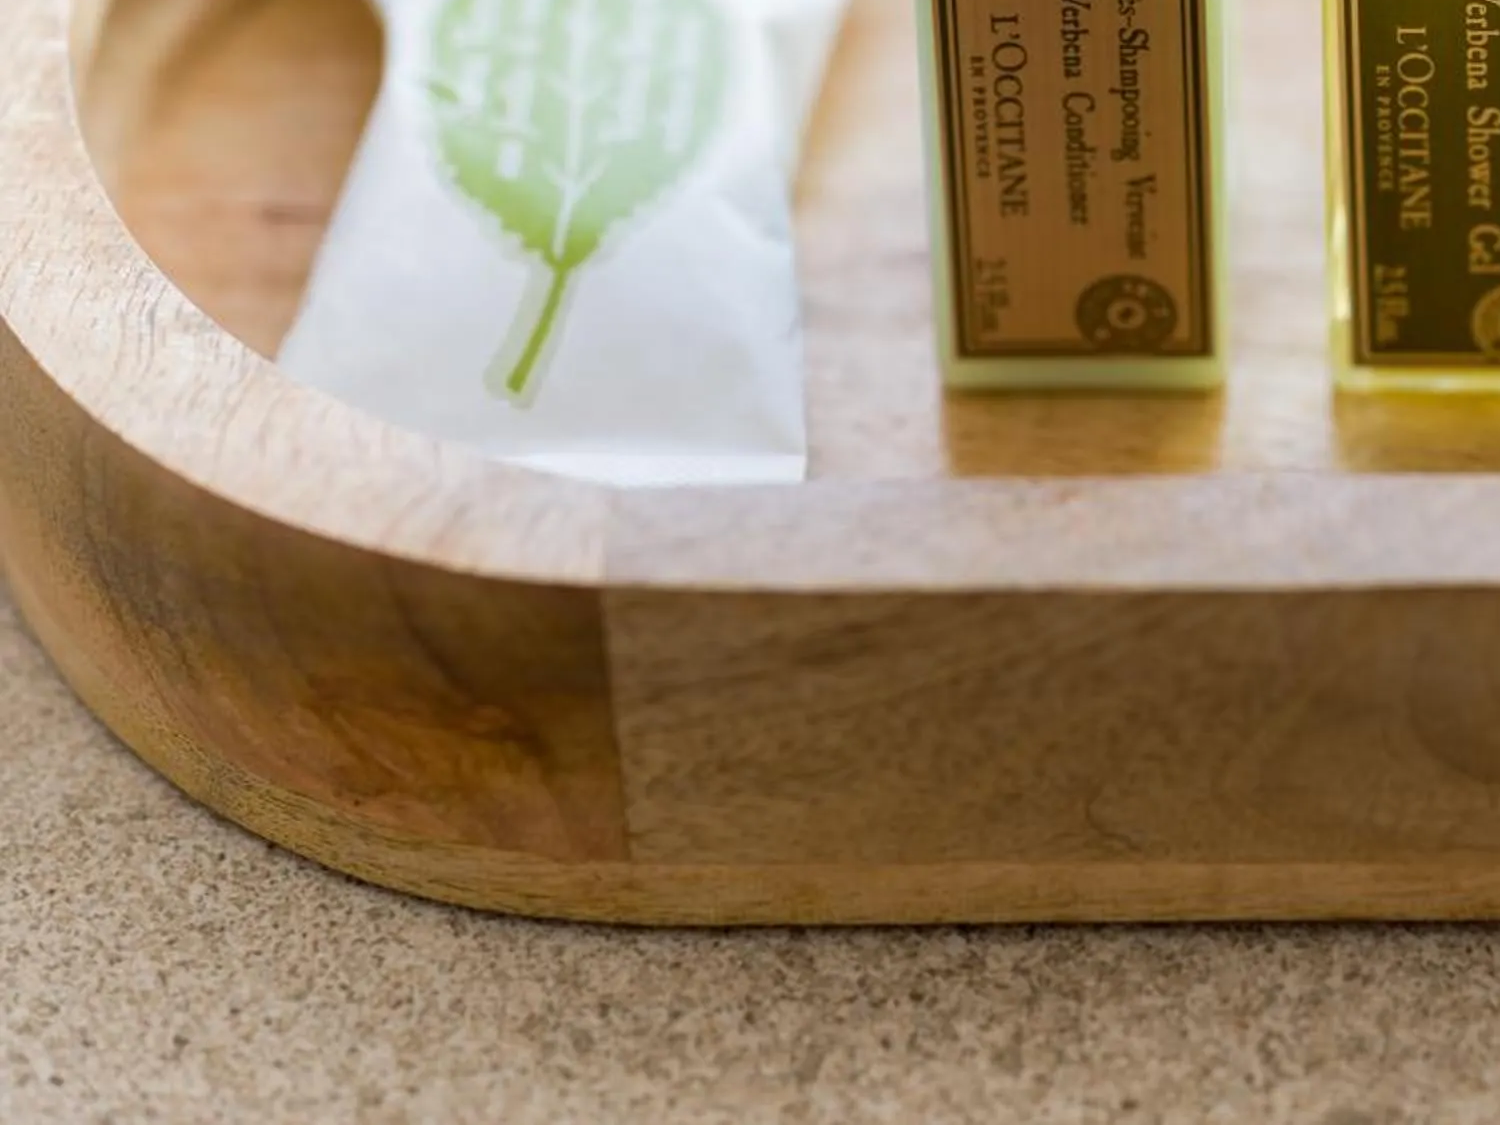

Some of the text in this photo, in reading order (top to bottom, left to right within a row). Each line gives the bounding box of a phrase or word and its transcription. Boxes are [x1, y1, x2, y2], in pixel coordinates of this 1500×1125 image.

[970, 56, 986, 77] EN
[990, 14, 1029, 218] L'OCCITANE
[1376, 65, 1394, 192] EN PROVENCE
[1396, 25, 1435, 230] L'OCCITANE
[1061, 92, 1096, 226] Conditioner
